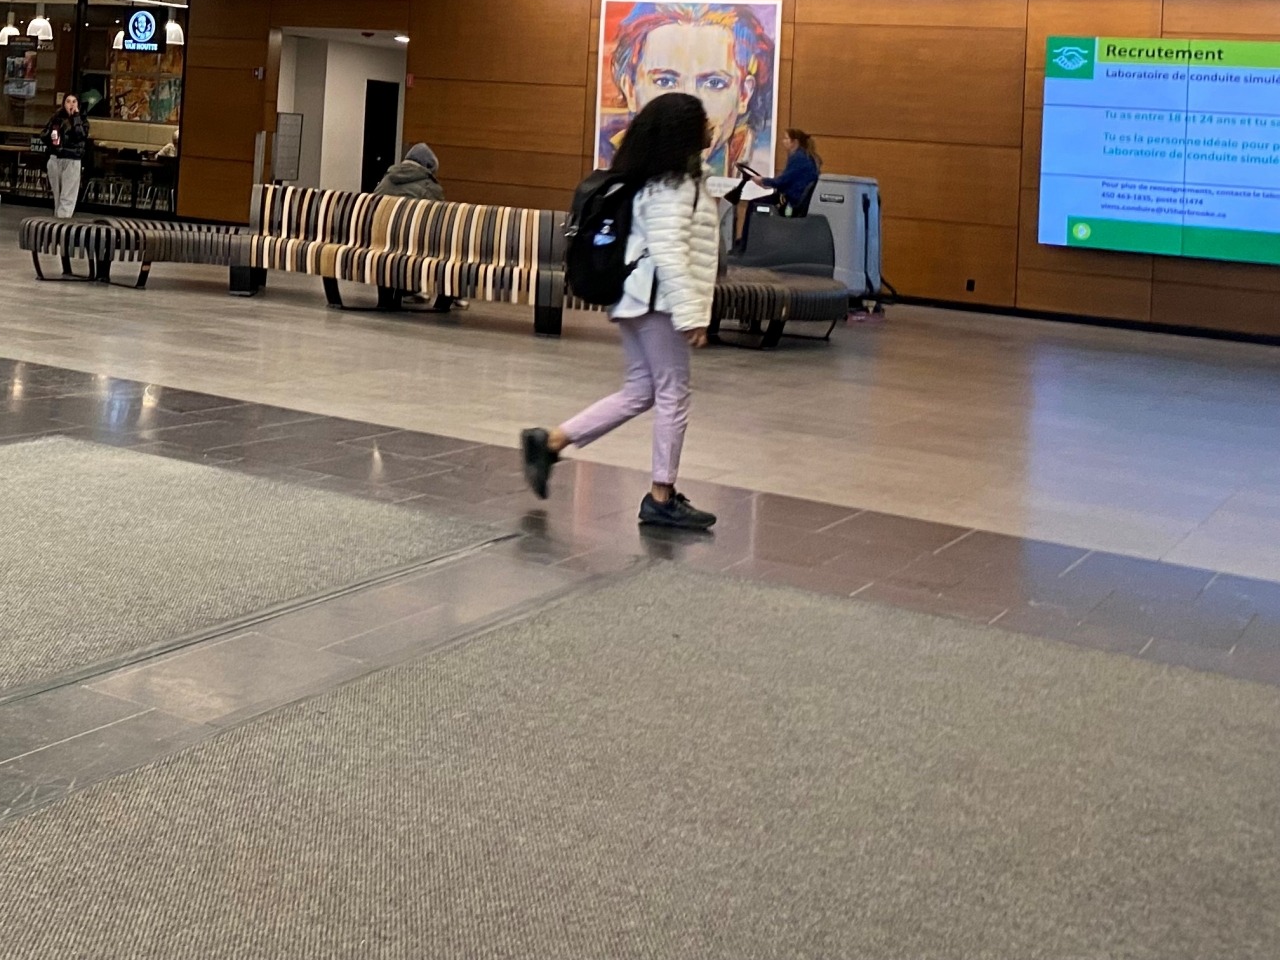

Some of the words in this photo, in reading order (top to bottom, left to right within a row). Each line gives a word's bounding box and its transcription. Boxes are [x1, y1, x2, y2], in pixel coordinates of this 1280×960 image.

[1106, 44, 1224, 60] Recrutement
[1106, 68, 1169, 80] Laboratoire
[1172, 71, 1185, 80] de
[1189, 72, 1240, 83] conduite
[1105, 110, 1117, 119] Tu
[1134, 113, 1164, 121] entre
[1169, 113, 1181, 122] 18
[1185, 115, 1196, 123] et
[1200, 115, 1213, 124] 24
[1216, 117, 1236, 125] ans
[1240, 117, 1251, 126] et
[1255, 118, 1267, 127] tu
[1104, 132, 1117, 141] Tu
[1119, 134, 1131, 142] es
[1134, 133, 1143, 142] la
[1147, 135, 1201, 146] personne
[1203, 136, 1238, 148] idéale
[1241, 140, 1269, 151] pour
[1103, 145, 1166, 158] Laboratoire
[1169, 148, 1183, 159] de
[1187, 150, 1238, 162] conduite
[1102, 181, 1119, 189] Pour
[1120, 182, 1137, 191] plus
[1138, 183, 1148, 191] de
